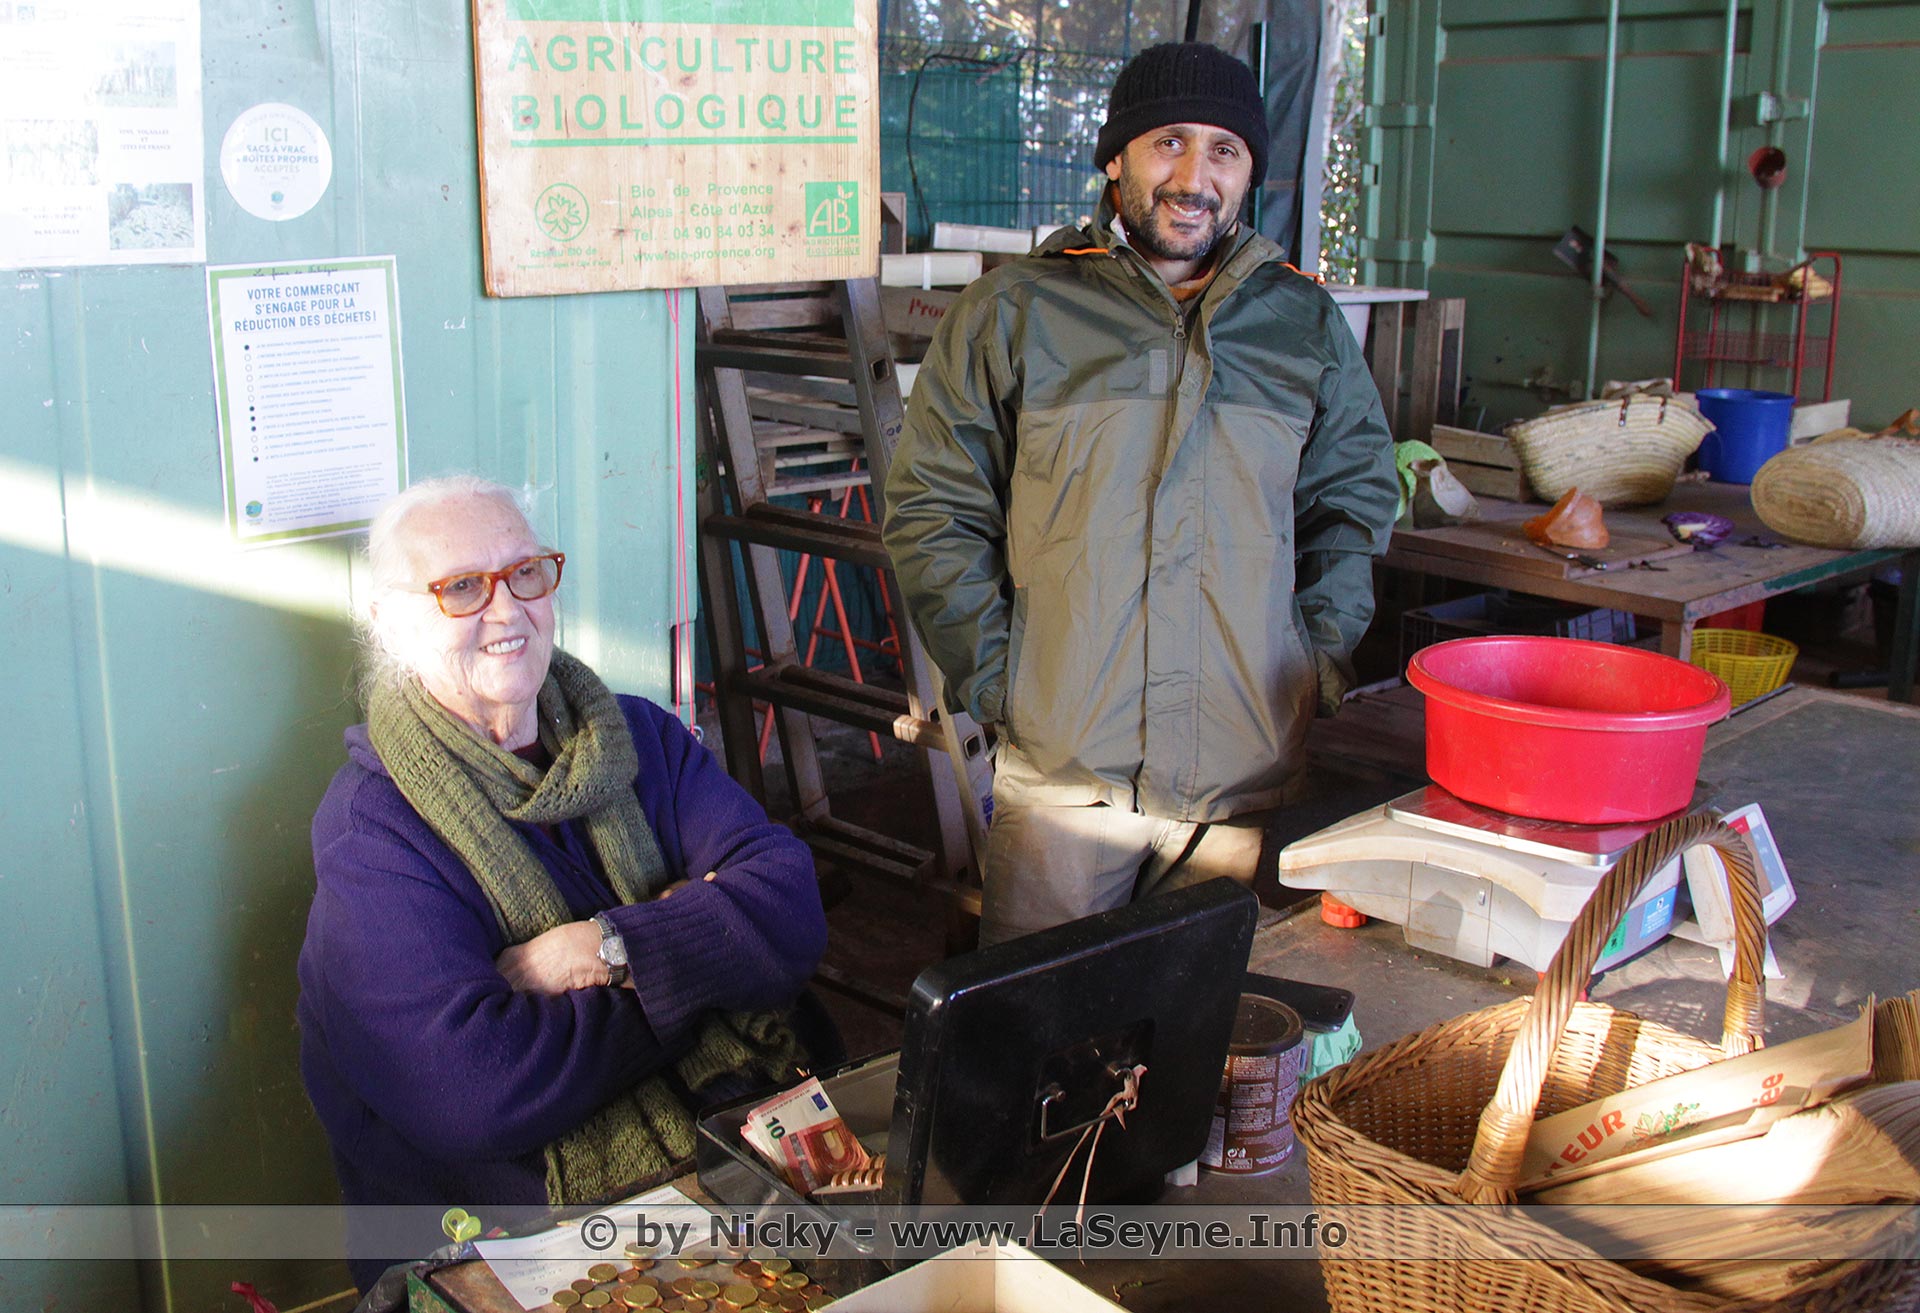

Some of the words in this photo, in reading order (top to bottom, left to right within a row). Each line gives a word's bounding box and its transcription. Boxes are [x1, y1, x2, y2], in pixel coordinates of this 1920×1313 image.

[507, 34, 858, 74] AGRICULTURE
[510, 93, 858, 132] BIOLOGIQUE
[264, 127, 288, 142] ICI
[277, 154, 319, 164] PROPRES
[631, 185, 656, 199] Bio
[673, 184, 690, 197] de
[707, 182, 773, 196] Provence
[631, 205, 673, 219] Alpes
[690, 203, 723, 217] Côte
[809, 198, 851, 235] AB
[673, 227, 690, 240] 04
[694, 226, 712, 239] 90
[738, 225, 754, 238] 03
[759, 224, 775, 237] 34
[247, 287, 281, 300] VOTRE
[285, 282, 360, 297] COMMERÇANT
[255, 300, 307, 315] S'ENGAGE
[311, 298, 340, 311] POUR
[343, 297, 355, 308] LA
[234, 317, 296, 332] RÉDUCTION
[300, 315, 321, 326] DES
[766, 1116, 786, 1140] 10
